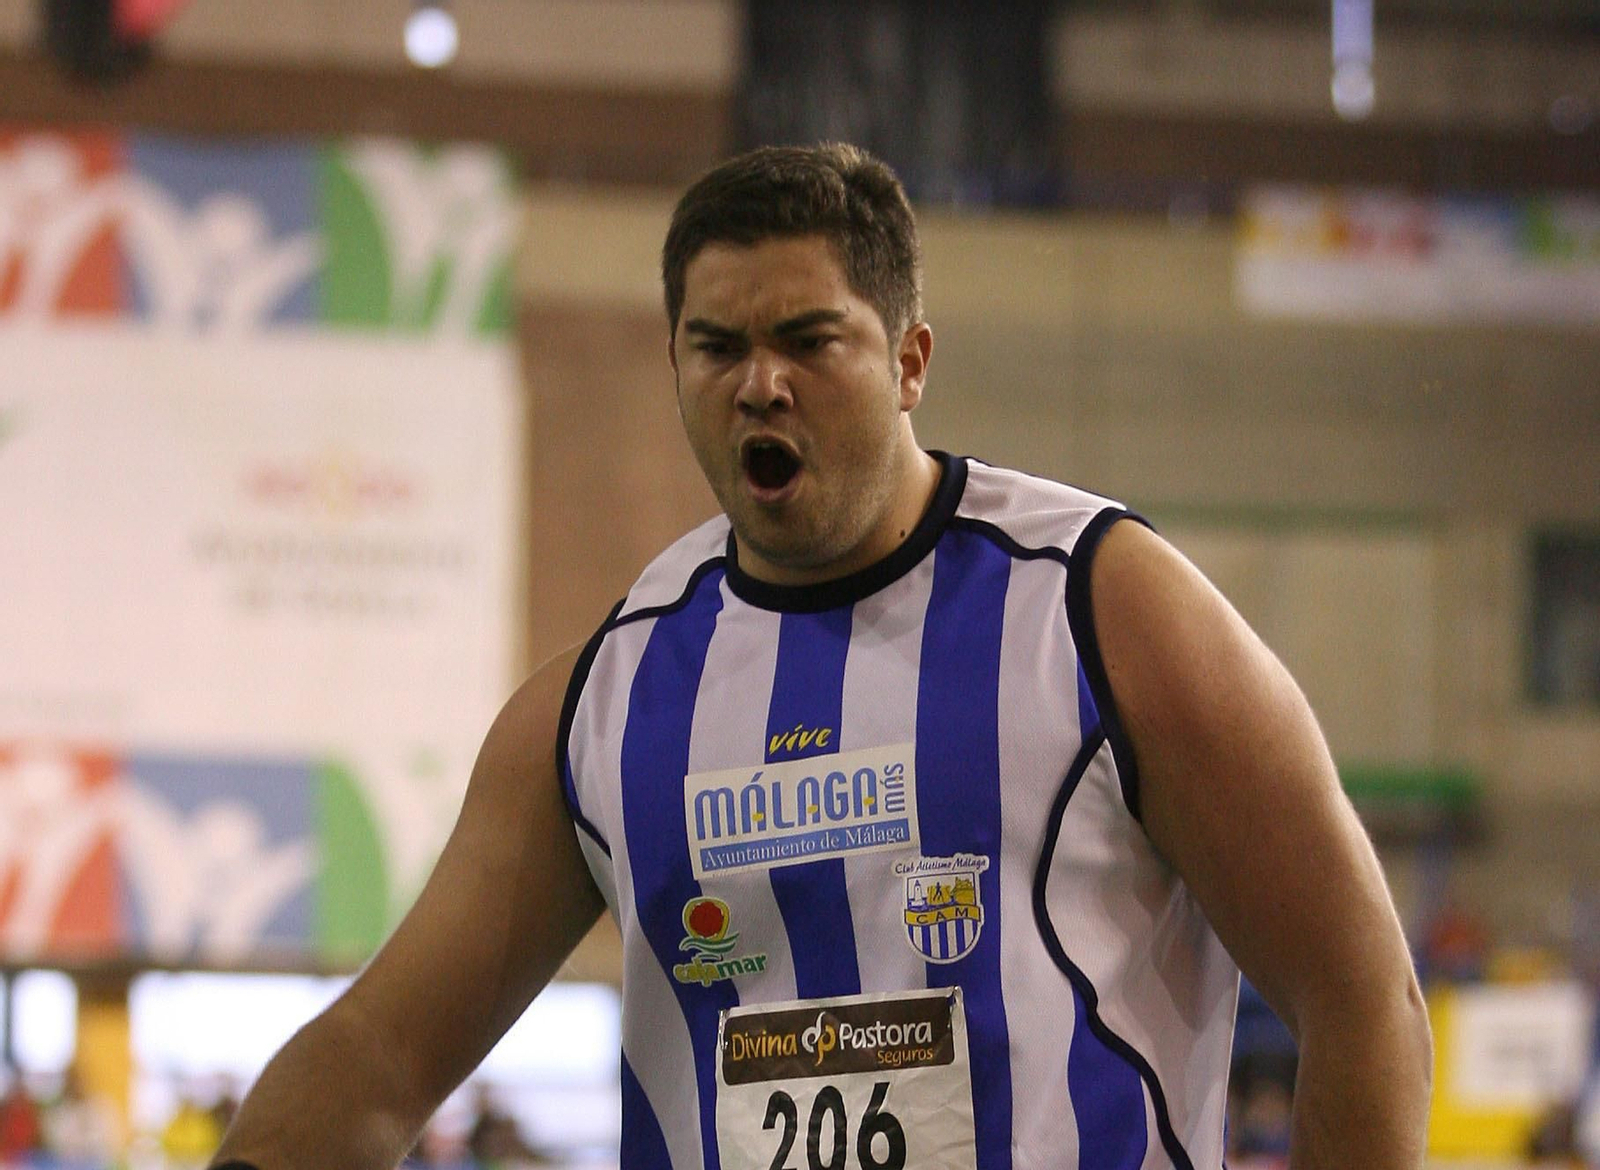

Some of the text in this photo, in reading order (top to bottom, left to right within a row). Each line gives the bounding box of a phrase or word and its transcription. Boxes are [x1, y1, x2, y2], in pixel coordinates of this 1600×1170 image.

[695, 771, 878, 840] MÁLAGA
[704, 824, 905, 869] Ayuntamiento de Málaga
[895, 862, 914, 874] Club
[674, 955, 766, 987] cajamar
[731, 1030, 798, 1061] Divina
[839, 1021, 932, 1049] Pastora
